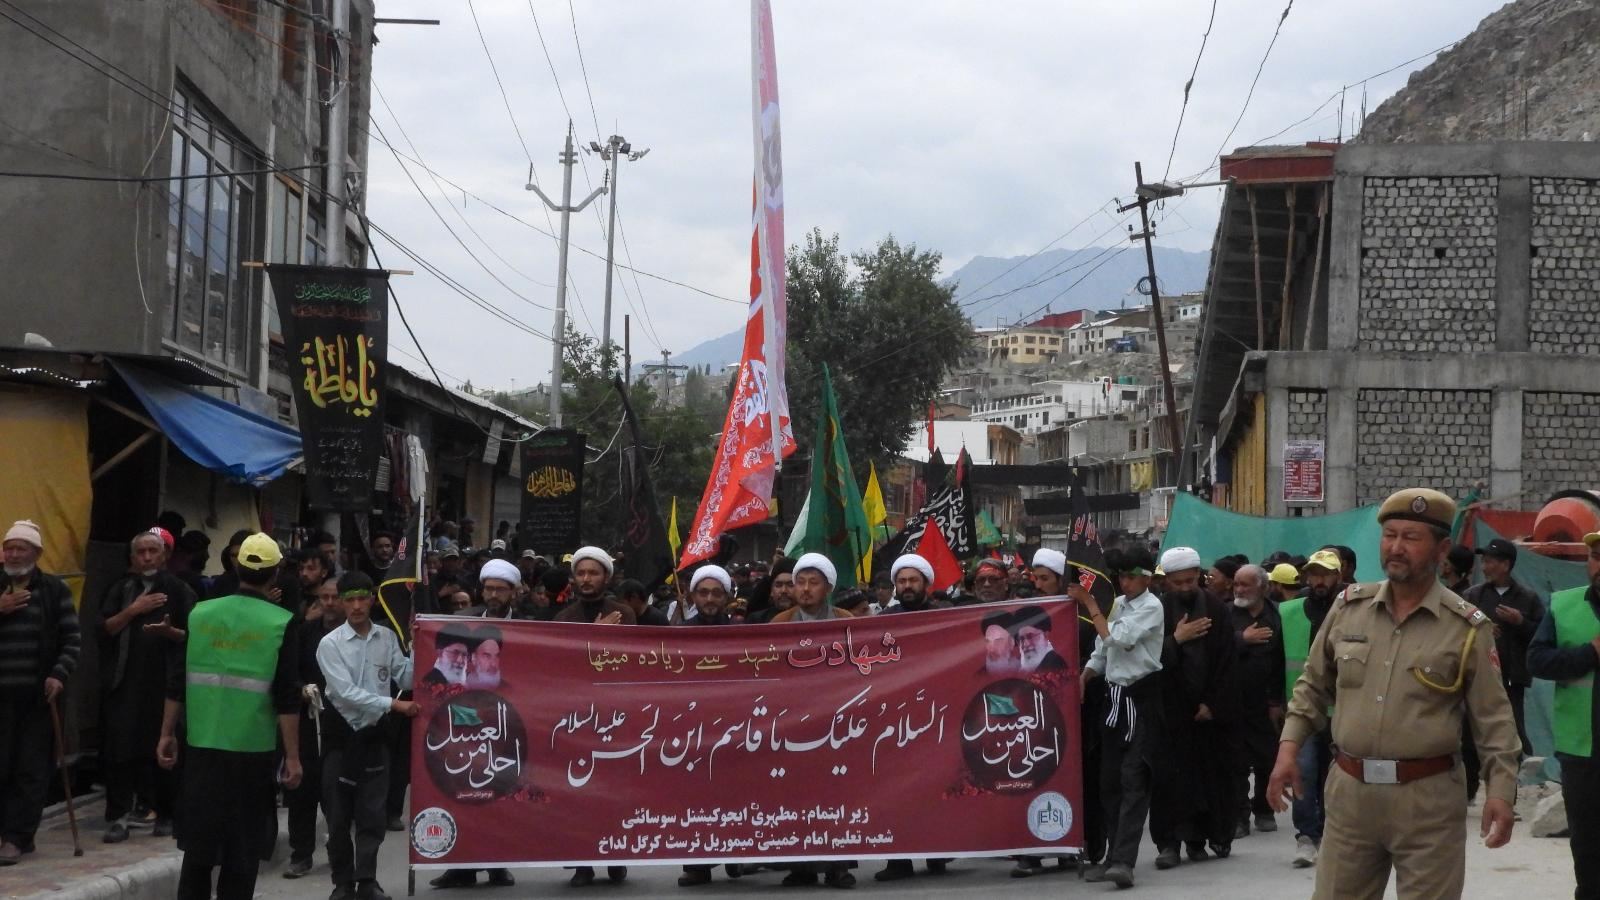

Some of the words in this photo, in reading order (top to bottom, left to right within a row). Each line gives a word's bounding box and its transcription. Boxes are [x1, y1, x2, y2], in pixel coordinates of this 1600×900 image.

[587, 641, 629, 672] میٹھا
[638, 641, 685, 673] زیادہ
[695, 654, 728, 670] سے
[962, 689, 1045, 740] العسل
[426, 701, 507, 751] العسل
[444, 742, 488, 774] من
[982, 731, 1025, 765] من
[622, 808, 677, 829] سوسائٹی
[680, 806, 747, 828] ایجوکیشنل
[848, 806, 869, 823] زیر
[598, 835, 627, 854] لداخ
[631, 834, 661, 853] کرگل
[665, 831, 701, 853] ٹرسٹ
[703, 833, 754, 852] میموریل
[803, 830, 828, 850] امام
[831, 829, 862, 849] تعلیم
[865, 829, 894, 847] شعبہ
